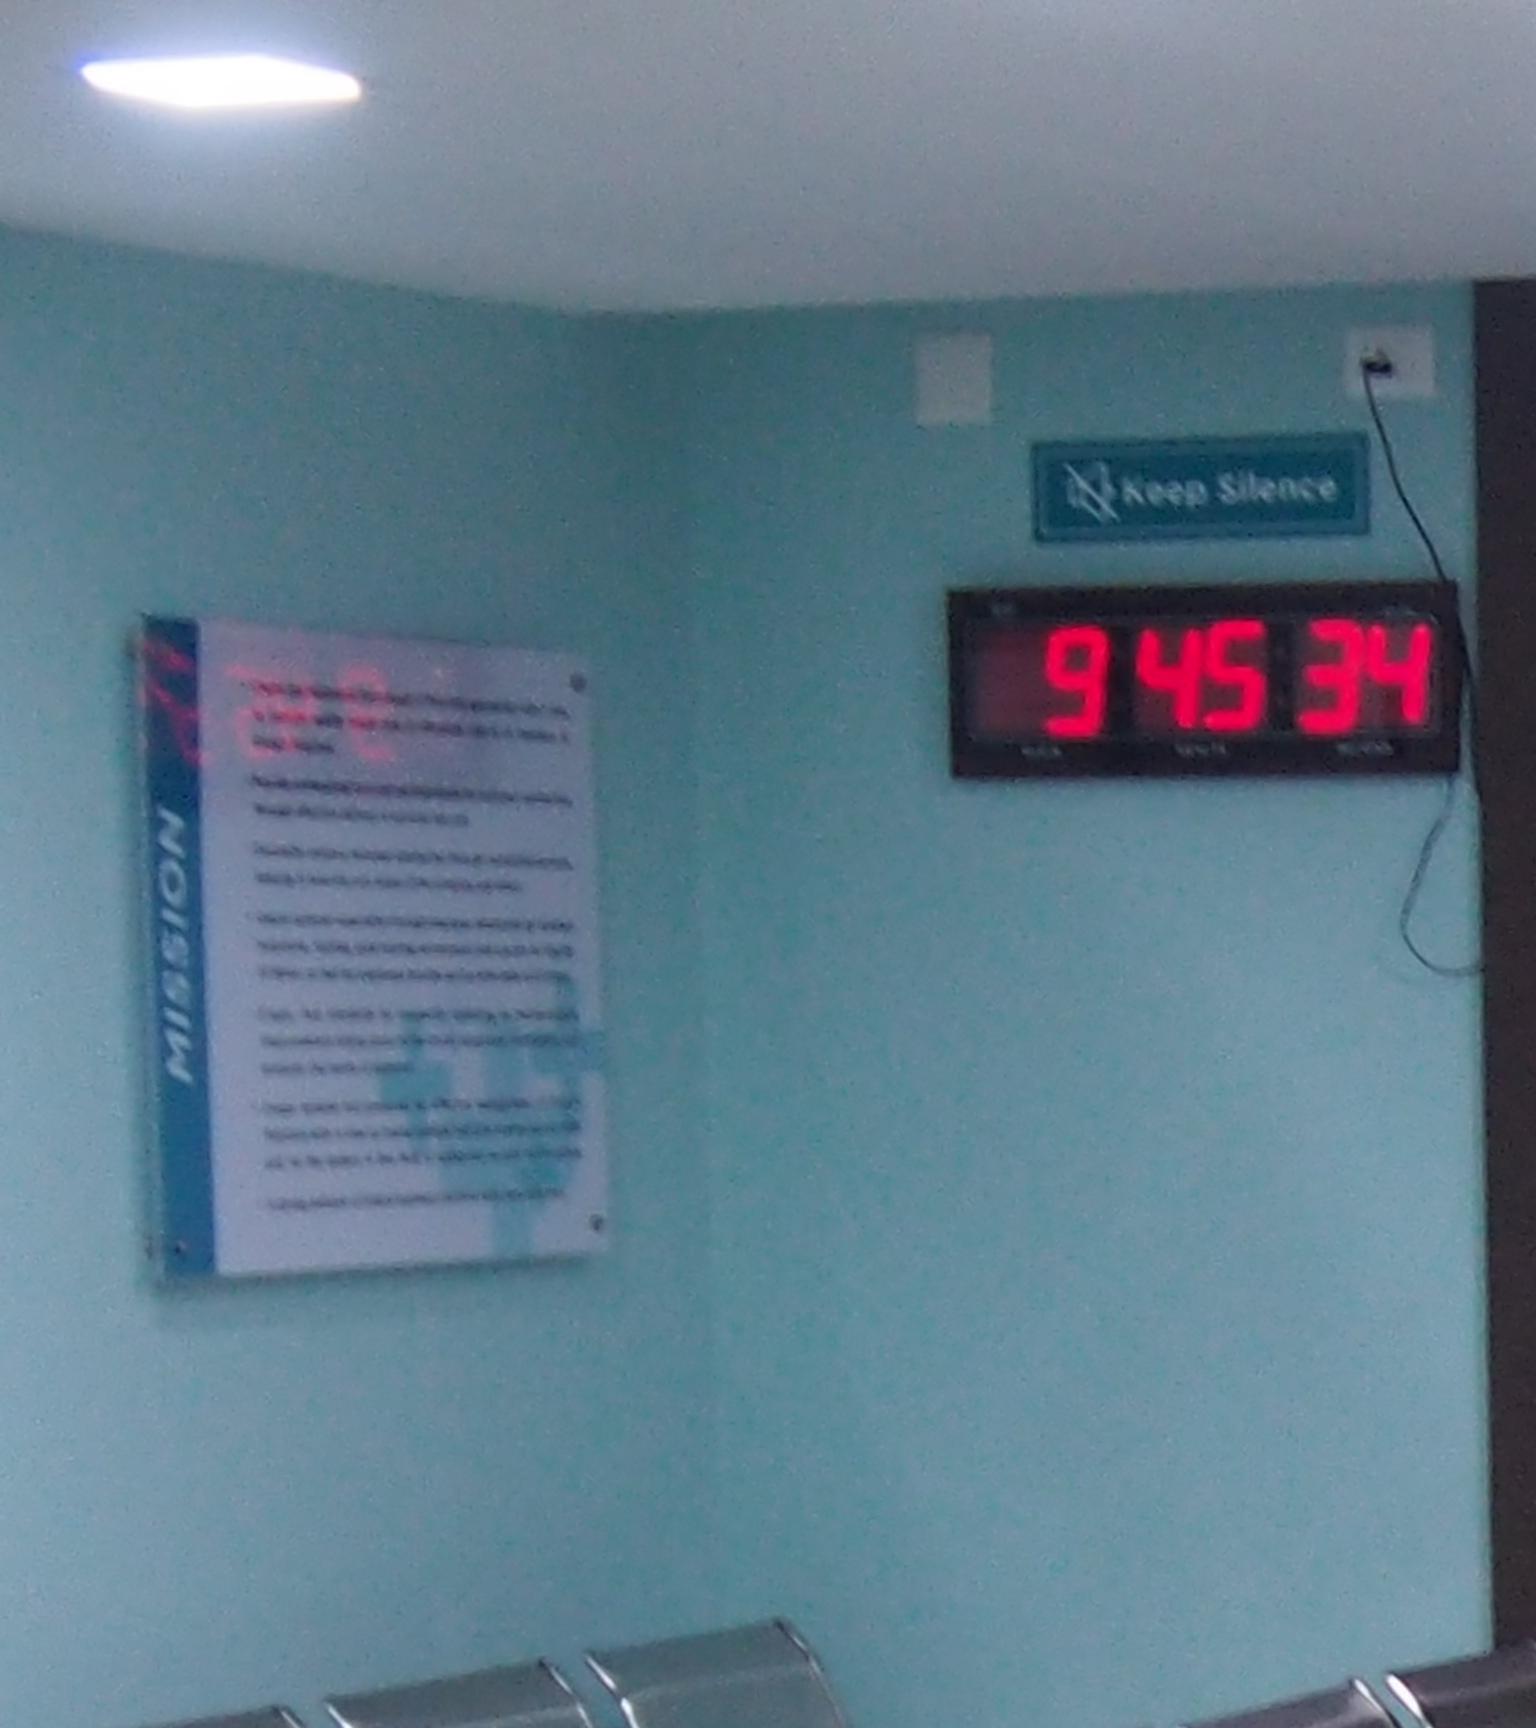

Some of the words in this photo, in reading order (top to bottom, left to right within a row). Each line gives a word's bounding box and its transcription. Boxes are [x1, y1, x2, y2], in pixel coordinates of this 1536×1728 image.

[1122, 475, 1208, 506] Keep
[1216, 467, 1338, 505] Silence
[1043, 624, 1110, 738] 9
[1134, 619, 1267, 731] 45
[1298, 617, 1433, 737] 34
[156, 806, 194, 1085] MISSION
